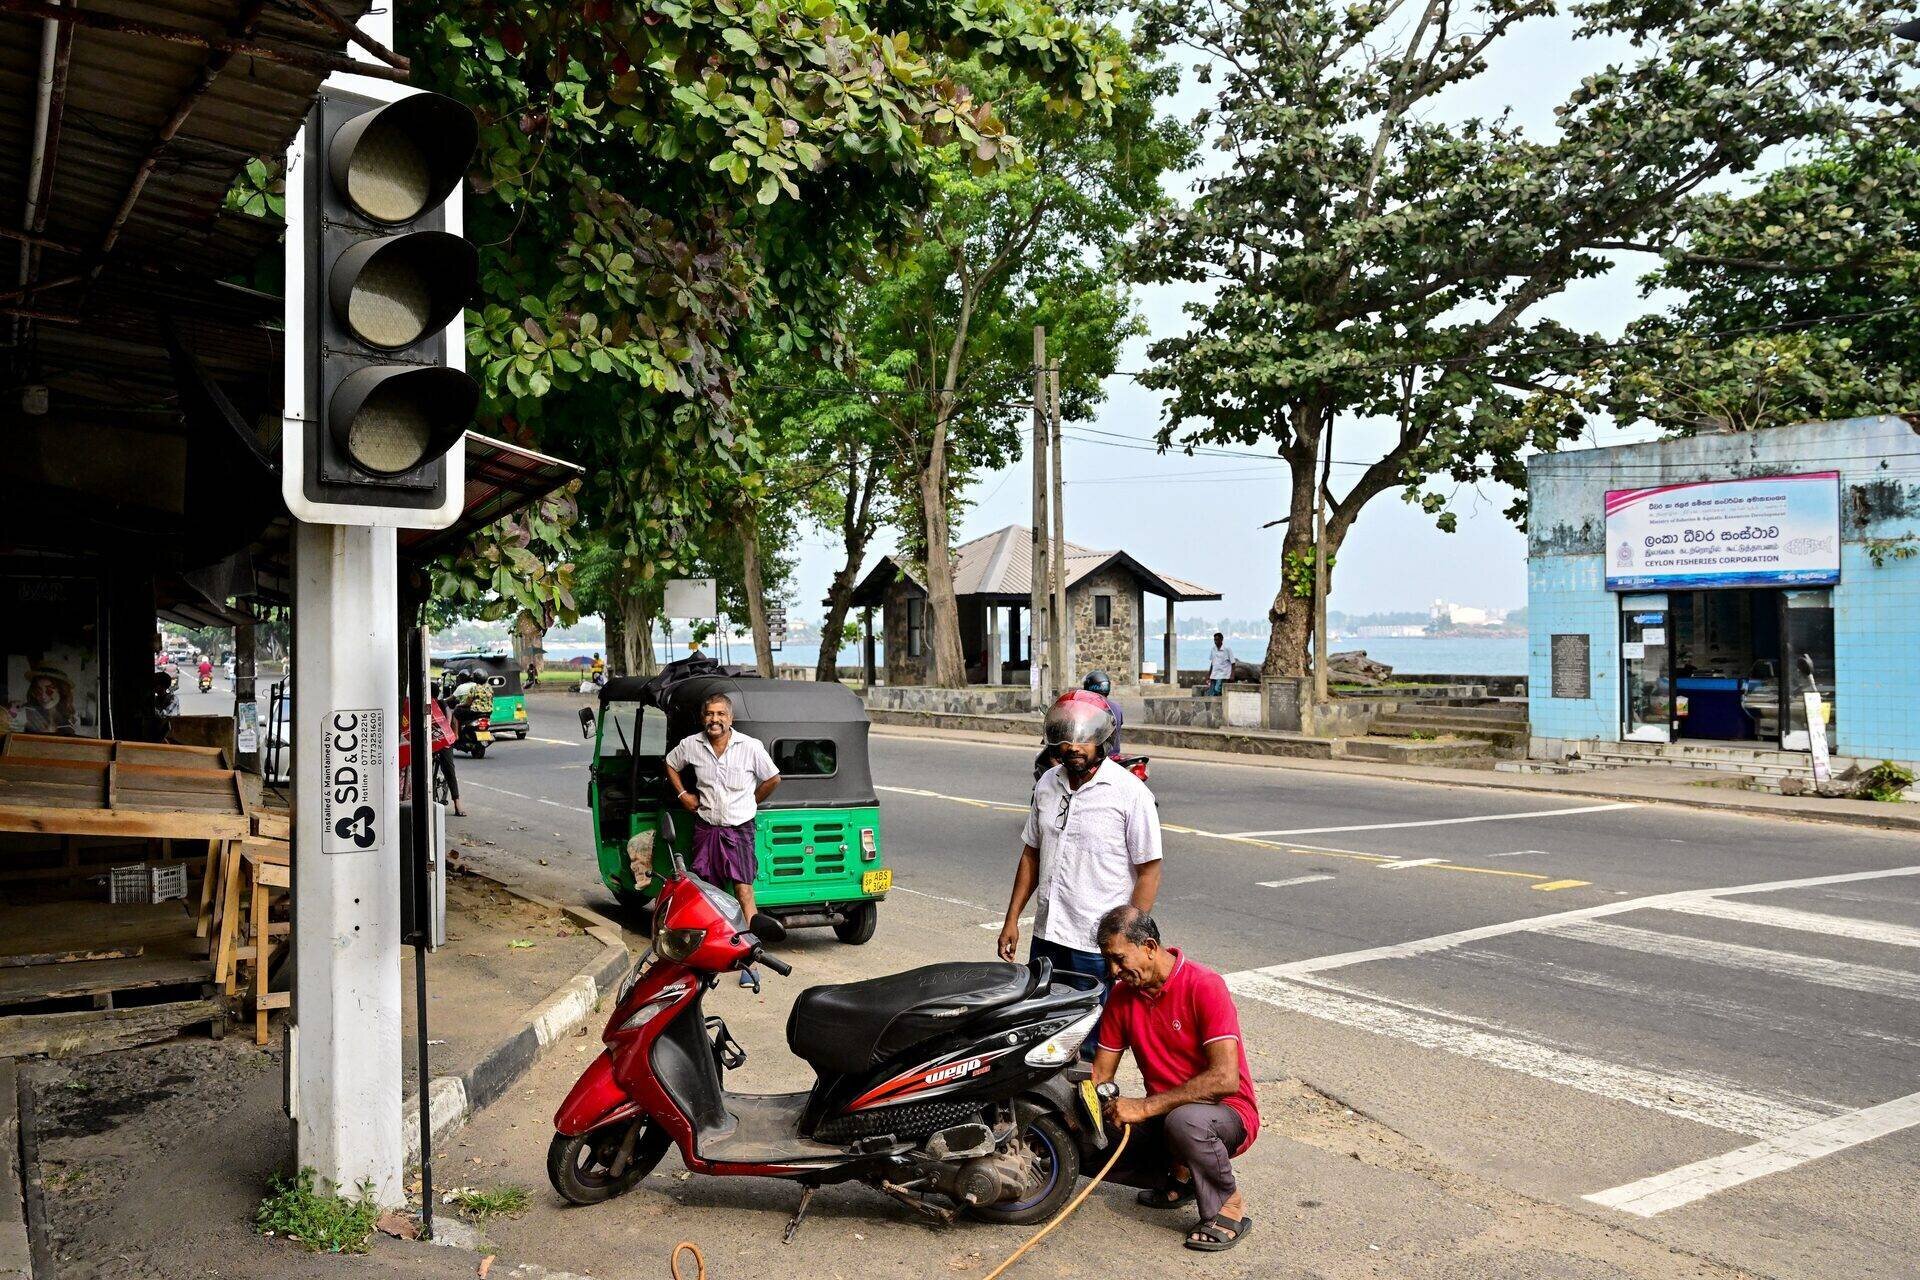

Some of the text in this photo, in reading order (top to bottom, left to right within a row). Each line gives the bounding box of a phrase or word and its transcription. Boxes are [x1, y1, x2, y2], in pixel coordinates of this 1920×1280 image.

[1645, 525, 1779, 547] ලංකා ධීවර සංස්ථාව
[1645, 555, 1779, 567] CEYLON FISHERIES CORPORATION
[324, 731, 332, 742] by
[333, 713, 359, 805] SD & CC
[874, 871, 888, 881] ABS
[924, 1058, 981, 1085] wego
